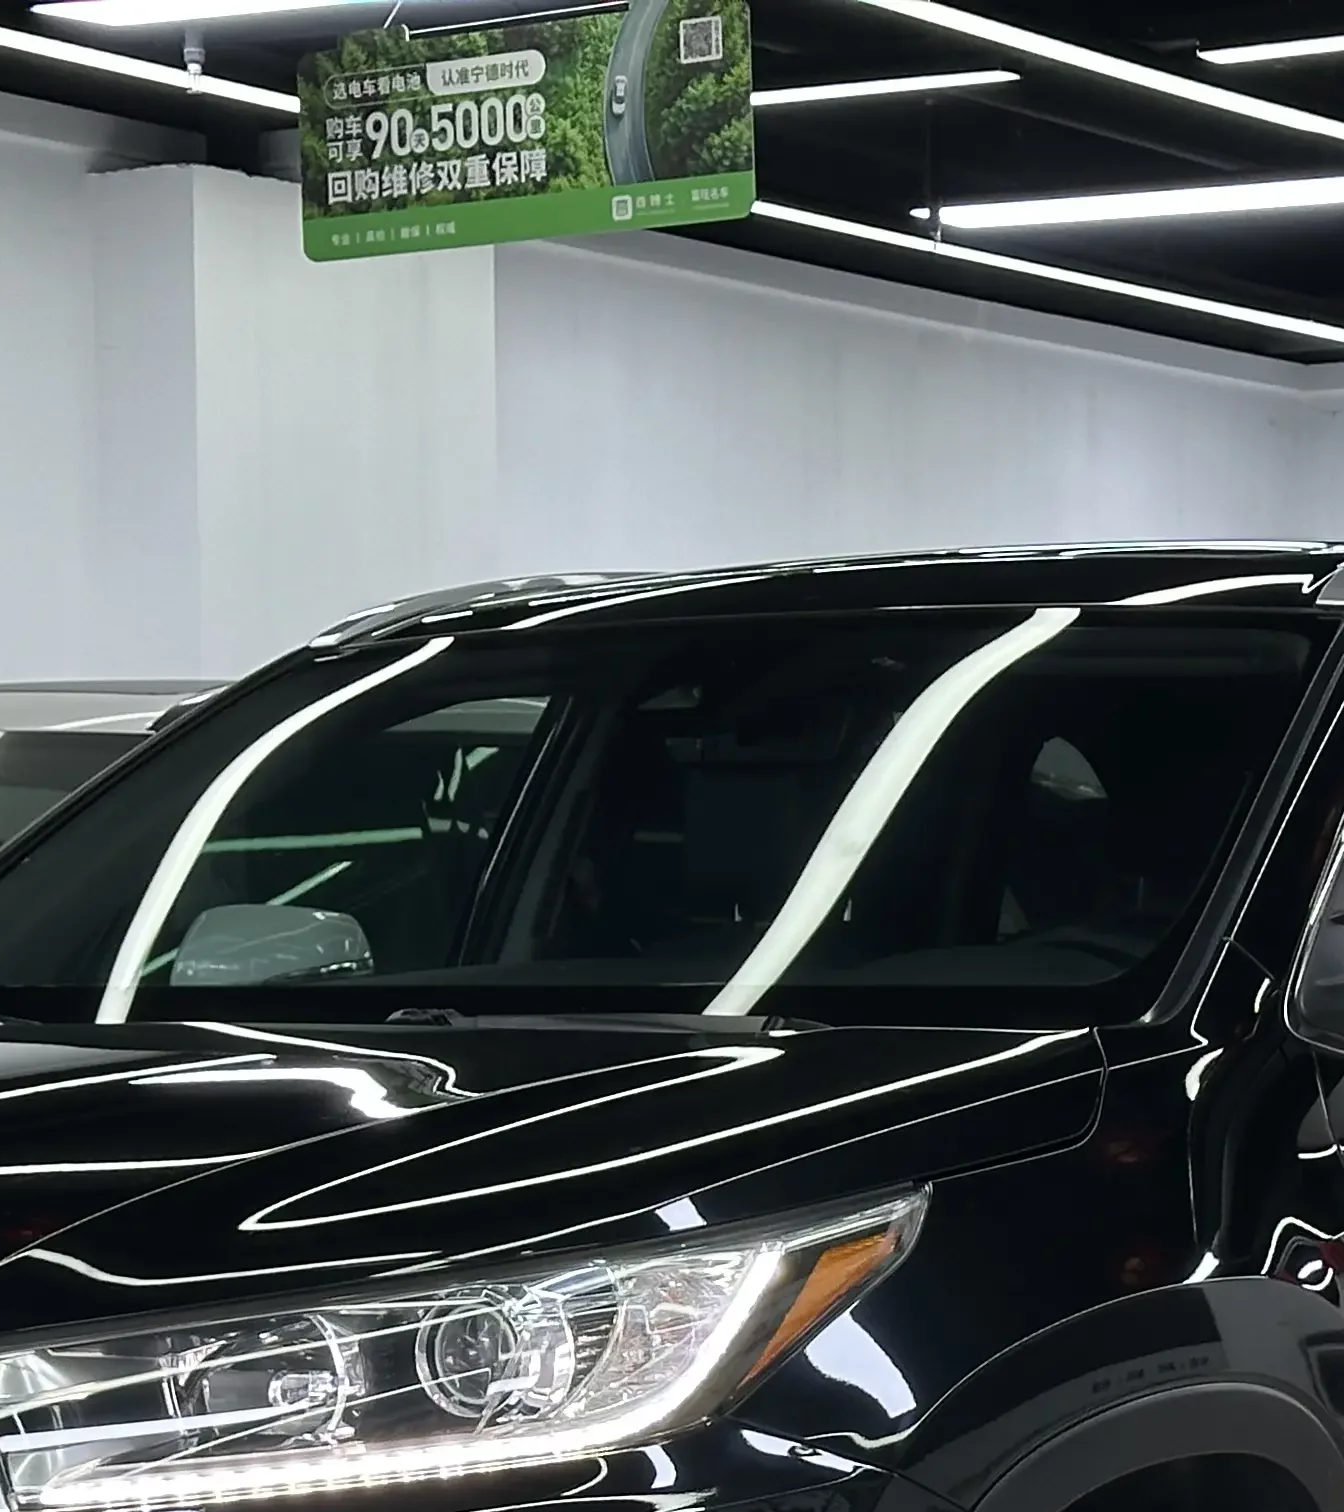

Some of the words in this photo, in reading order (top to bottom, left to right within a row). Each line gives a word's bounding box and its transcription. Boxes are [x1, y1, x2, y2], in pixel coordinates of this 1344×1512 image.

[441, 59, 529, 87] 认准宁德时代
[327, 148, 547, 204] 回购维修双重保障
